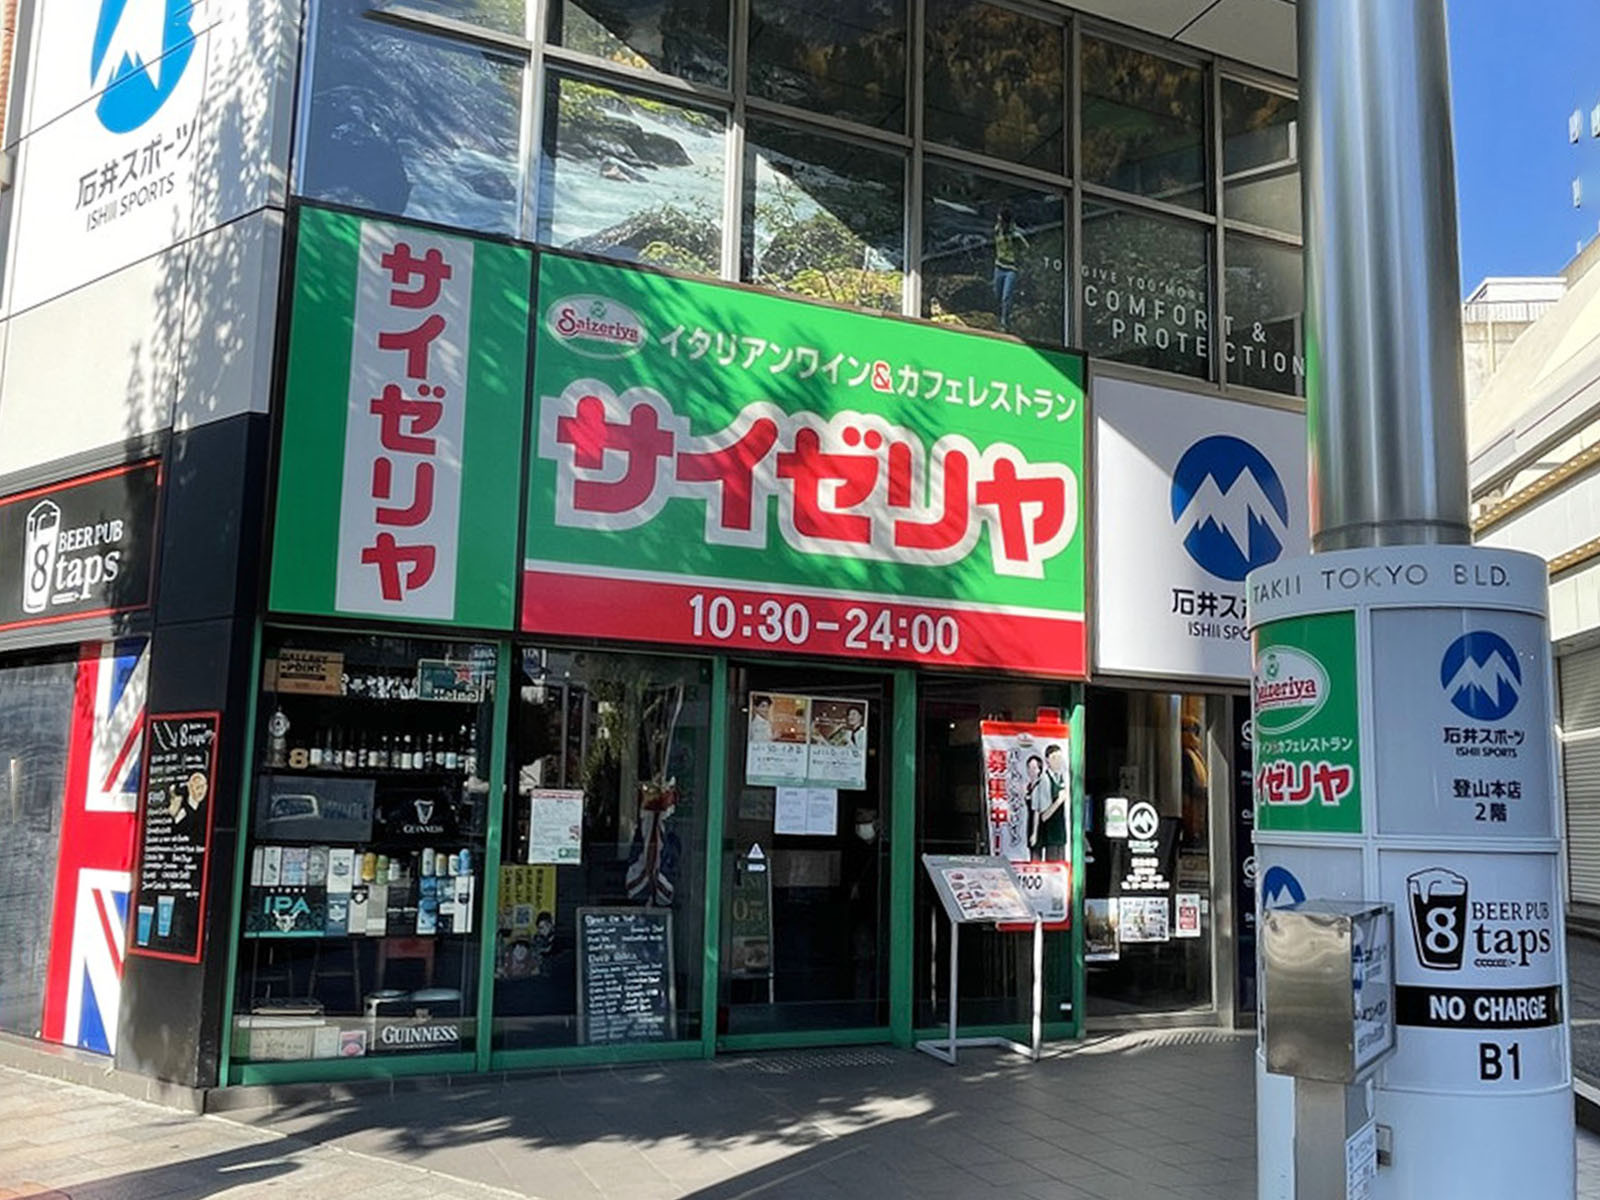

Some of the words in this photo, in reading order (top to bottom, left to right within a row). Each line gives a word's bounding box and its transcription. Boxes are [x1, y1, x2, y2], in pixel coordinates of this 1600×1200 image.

[75, 118, 196, 211] 石井スポーツ
[86, 199, 118, 232] ISHII
[120, 171, 175, 216] SPORTS
[1043, 257, 1062, 271] TO
[1081, 265, 1118, 284] GIVE
[1165, 283, 1206, 303] MORE
[558, 308, 638, 342] Saizeriya
[1084, 284, 1234, 337] COMFORT
[1251, 321, 1267, 343] &
[1112, 318, 1305, 376] PROTECTION
[361, 242, 452, 602] サイゼリヤ
[553, 391, 1068, 566] サイゼリヤ
[58, 525, 93, 553] BEER
[94, 519, 124, 546] PUB
[56, 551, 120, 599] taps
[1254, 575, 1301, 602] TAKII
[1322, 564, 1428, 590] TOKYO
[1454, 564, 1510, 587] BLD.
[1172, 588, 1248, 620] 石井ス
[1188, 621, 1221, 639] ISHII
[1443, 727, 1525, 745] 石井スポーツ
[1453, 779, 1522, 800] 登山本店
[263, 896, 311, 915] IPA
[1472, 901, 1522, 921] BEER
[1526, 902, 1549, 920] PUB
[1425, 905, 1459, 954] 8
[1473, 923, 1552, 967] taps
[1429, 995, 1465, 1021] NO
[1473, 996, 1547, 1022] CHARGE
[382, 1024, 459, 1044] GUINNESS
[1480, 1043, 1521, 1081] B1
